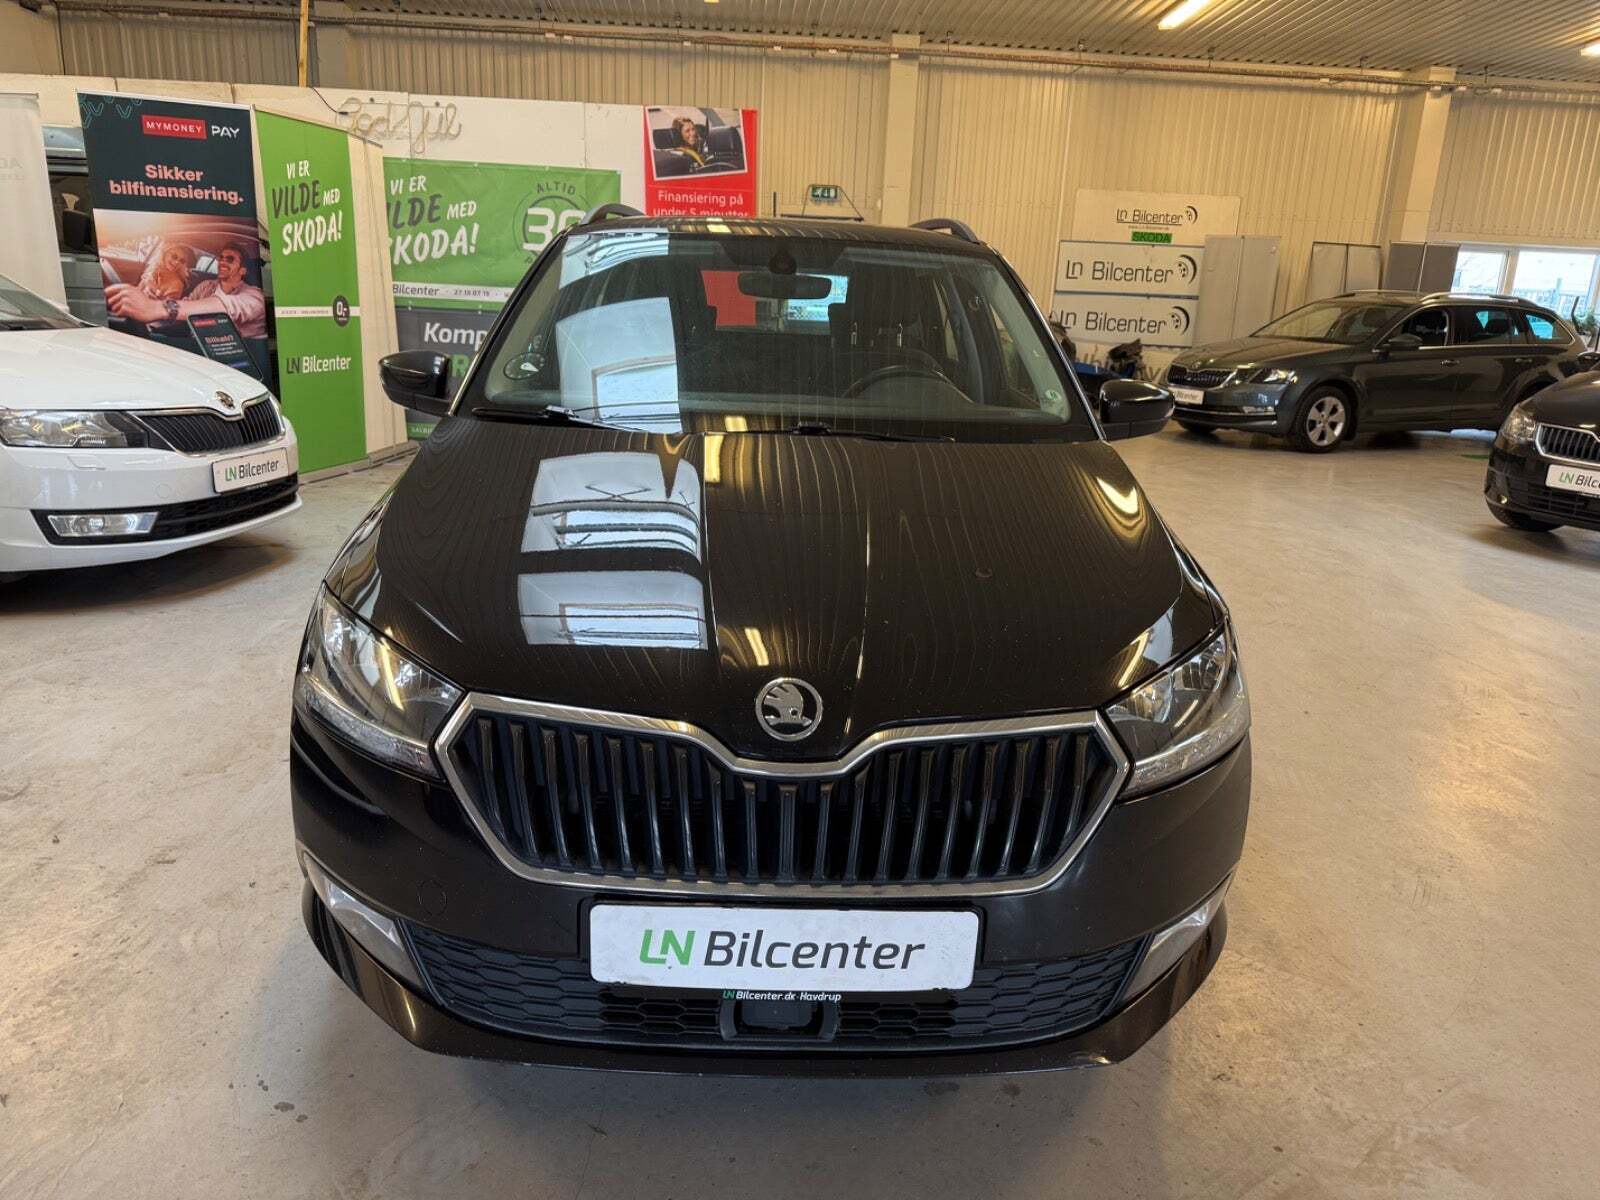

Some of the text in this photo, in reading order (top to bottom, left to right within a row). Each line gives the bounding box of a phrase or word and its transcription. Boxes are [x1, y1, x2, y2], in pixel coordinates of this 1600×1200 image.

[146, 121, 240, 138] MYMONEY PAY
[145, 164, 204, 182] Sikker
[286, 159, 310, 180] VI ER
[109, 180, 244, 206] bilfinansiering.
[390, 175, 427, 196] VI ER
[536, 181, 576, 196] ALTID
[272, 180, 341, 219] VILDE MED
[658, 190, 744, 207] Finansiering på
[446, 200, 477, 220] MED
[1132, 208, 1184, 224] Bilcenter
[282, 209, 343, 256] SKODA!
[1132, 232, 1171, 244] SKODA
[389, 222, 480, 265] KODA!
[1091, 261, 1174, 284] Bilcenter
[392, 284, 440, 297] Bilcenter
[1085, 311, 1168, 335] Bilcenter
[286, 355, 352, 374] LN Bilcenter
[225, 459, 279, 482] LN Bilcenter
[1559, 472, 1600, 488] LN Bilc
[639, 929, 926, 970] LN Bilcenter
[722, 990, 841, 1003] LN Bilcenter.dk Havdrup
